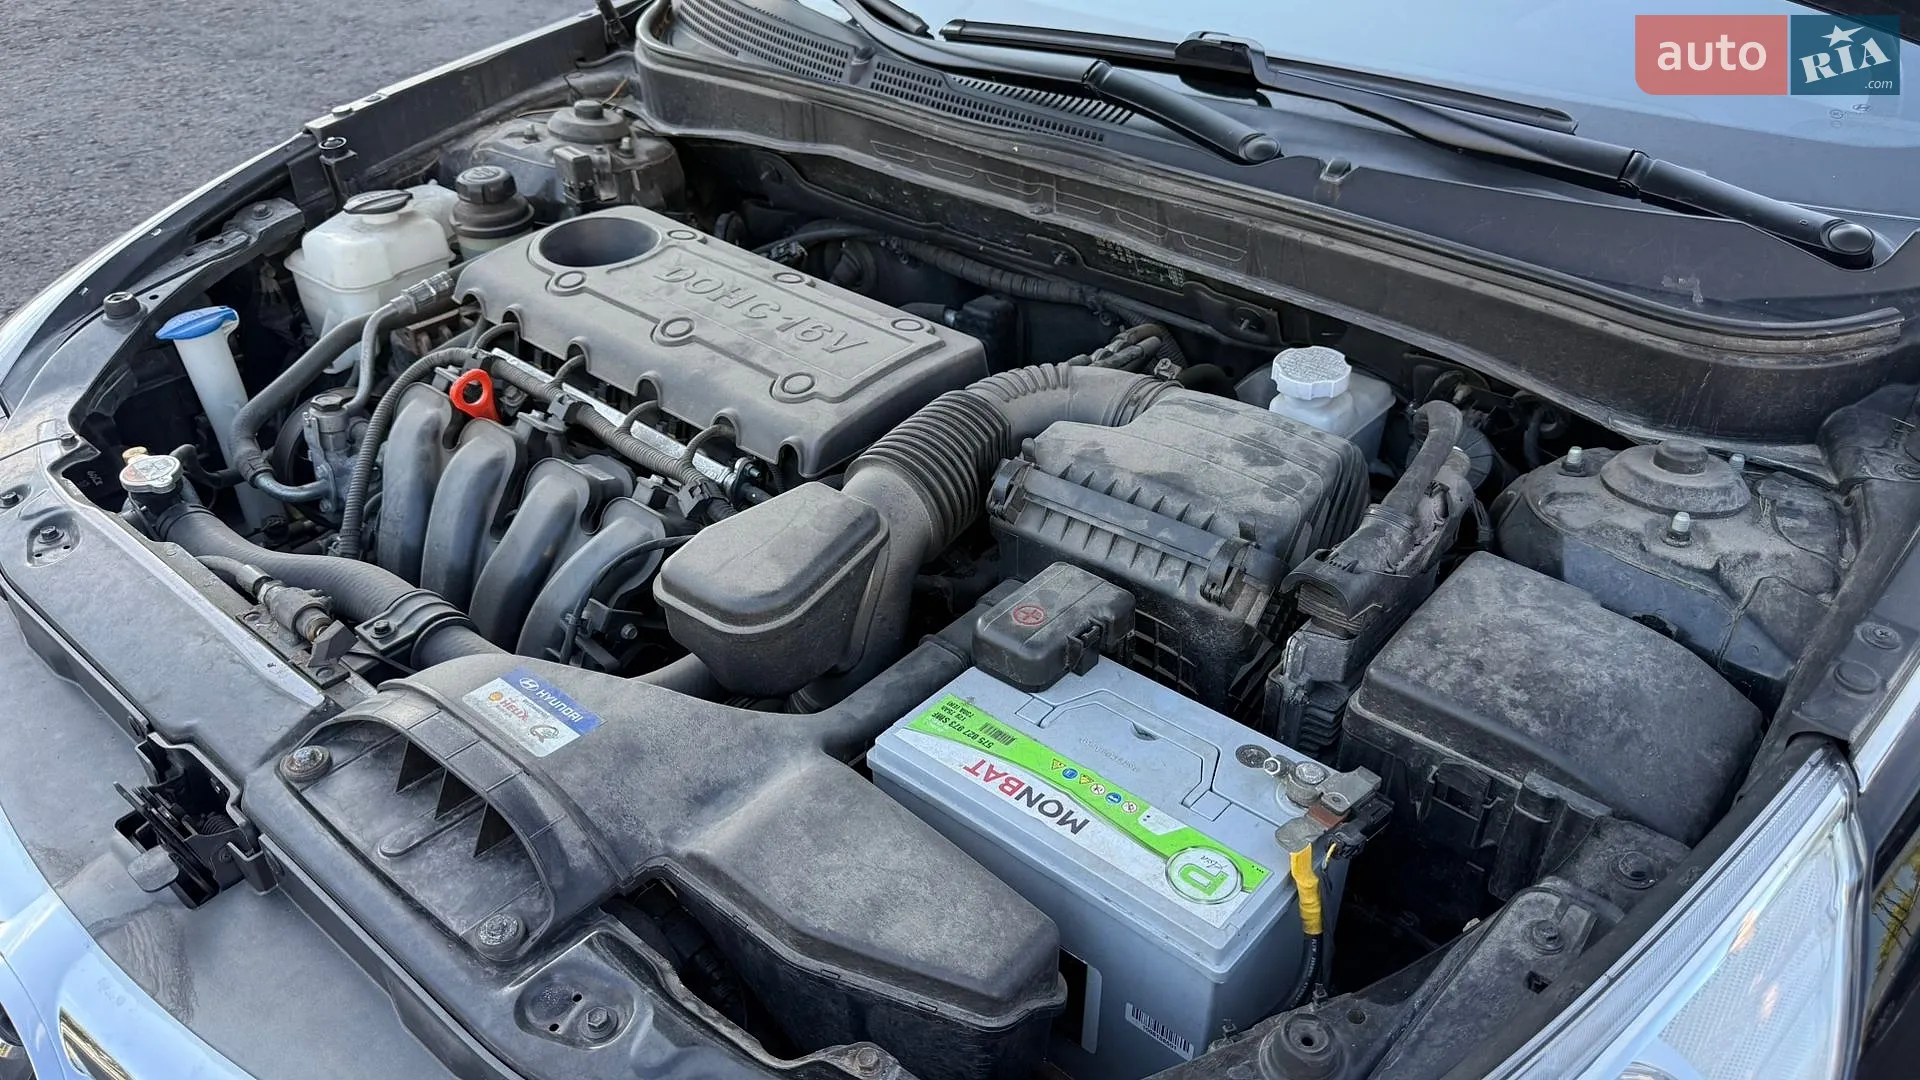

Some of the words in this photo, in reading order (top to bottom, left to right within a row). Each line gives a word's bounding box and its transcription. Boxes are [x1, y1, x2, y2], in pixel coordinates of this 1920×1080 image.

[654, 266, 782, 320] DOHC
[776, 316, 869, 354] 16V
[500, 700, 529, 721] HELIX
[536, 690, 584, 722] HYUNDAI
[979, 737, 994, 748] 575
[963, 759, 1090, 835] MONBAT
